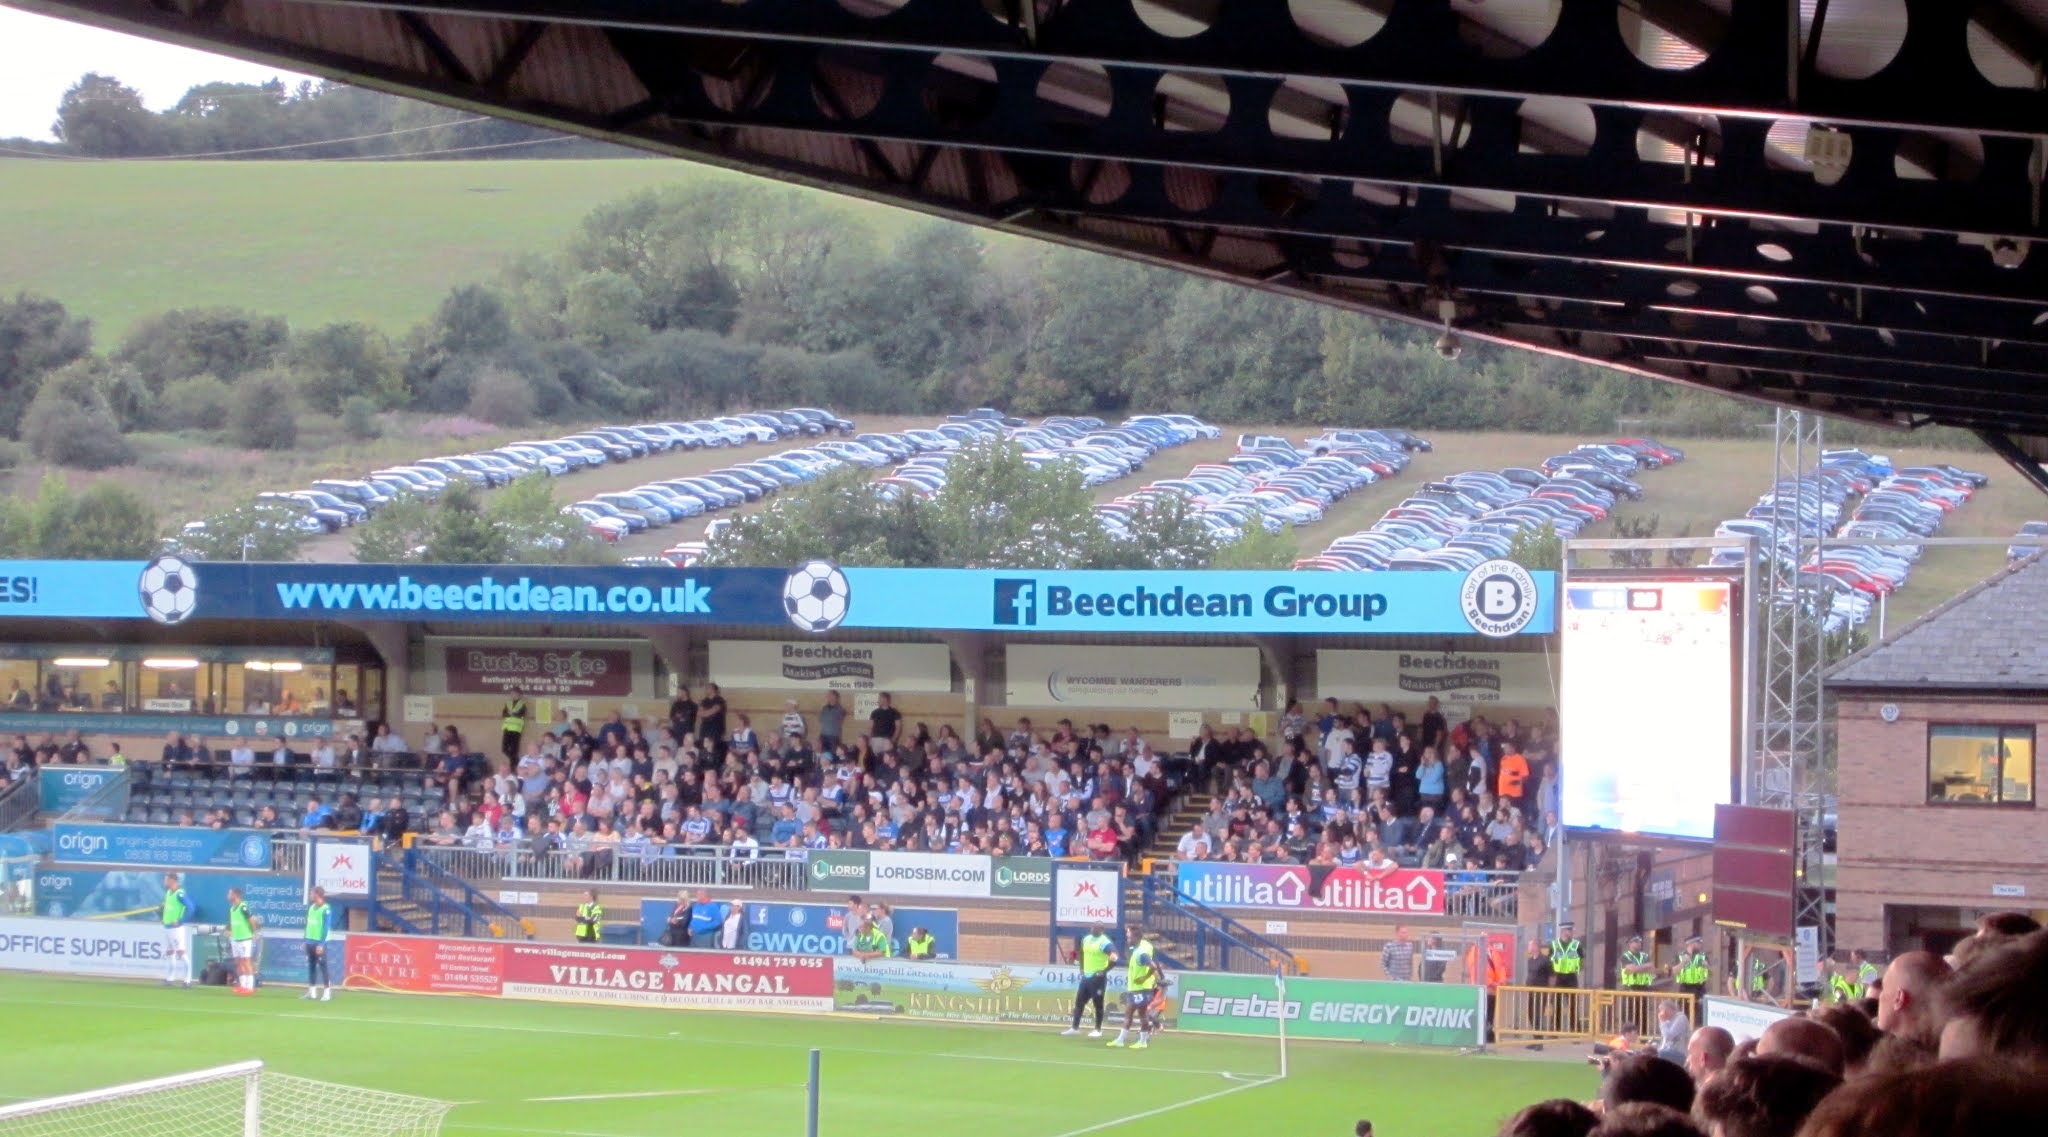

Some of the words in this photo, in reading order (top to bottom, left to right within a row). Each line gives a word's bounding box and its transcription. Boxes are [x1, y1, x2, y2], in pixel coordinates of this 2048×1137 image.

[1465, 578, 1479, 599] Part
[1478, 566, 1488, 578] of
[1490, 563, 1508, 572] the
[1511, 566, 1533, 600] Family
[276, 577, 711, 613] www.beechdean.co.uk
[1484, 581, 1516, 614] B
[1047, 585, 1252, 617] Beechdean
[1264, 585, 1388, 621] Group
[1468, 609, 1530, 633] Beechdean
[782, 644, 873, 659] Beechdean
[467, 651, 538, 672] Bucks
[544, 651, 607, 677] Spice
[1400, 653, 1499, 670] Beechdean
[783, 668, 821, 679] Making
[823, 666, 838, 676] Ice
[840, 664, 872, 676] Cream
[482, 676, 522, 684] Authentic
[525, 677, 551, 685] Indian
[554, 677, 594, 687] Takeaway
[1066, 676, 1117, 686] WYCOMBE
[1120, 676, 1182, 687] WANDERERS
[1401, 679, 1441, 691] Making
[1443, 678, 1460, 687] Ice
[1463, 675, 1497, 688] Cream
[1450, 692, 1475, 700] Since
[1477, 692, 1500, 701] 1989
[302, 721, 329, 735] origin
[64, 771, 102, 789] origin
[59, 832, 108, 855] origin
[829, 864, 866, 877] LORDS
[875, 866, 985, 883] LORDSBM.COM
[1013, 870, 1050, 884] LORDS
[40, 874, 72, 890] origin
[319, 877, 366, 890] printkick
[1183, 873, 1273, 904] utilita
[246, 884, 293, 896] Designed
[1313, 878, 1402, 909] utilita
[248, 899, 308, 911] anufacture
[1059, 904, 1114, 919] printkick
[267, 914, 306, 925] Wycom
[0, 934, 65, 954] OFFICE
[355, 952, 412, 965] CURRY
[434, 953, 455, 961] Indian
[457, 954, 495, 963] Restaurant
[514, 947, 626, 960] www.villagemangal.com
[733, 956, 770, 967] 01494
[774, 957, 796, 967] 729
[800, 957, 823, 968] 055
[350, 965, 418, 979] CENTRE
[444, 973, 468, 982] 01494
[550, 964, 664, 990] VILLAGE
[673, 972, 789, 994] MANGAL
[513, 984, 581, 997] MEDITERRANEAN
[581, 990, 618, 999] TURKISH
[619, 992, 649, 1001] CUISINE
[1133, 993, 1144, 1004] 23
[654, 994, 698, 1004] CHARCOAL
[701, 996, 724, 1004] GRILL
[758, 998, 774, 1006] BAR
[777, 999, 823, 1008] AMERSHAM
[909, 991, 1023, 1013] KINGSHILL
[1182, 990, 1302, 1020] Carabao
[1309, 1001, 1399, 1025] ENERGY
[1405, 1005, 1474, 1029] DRINK
